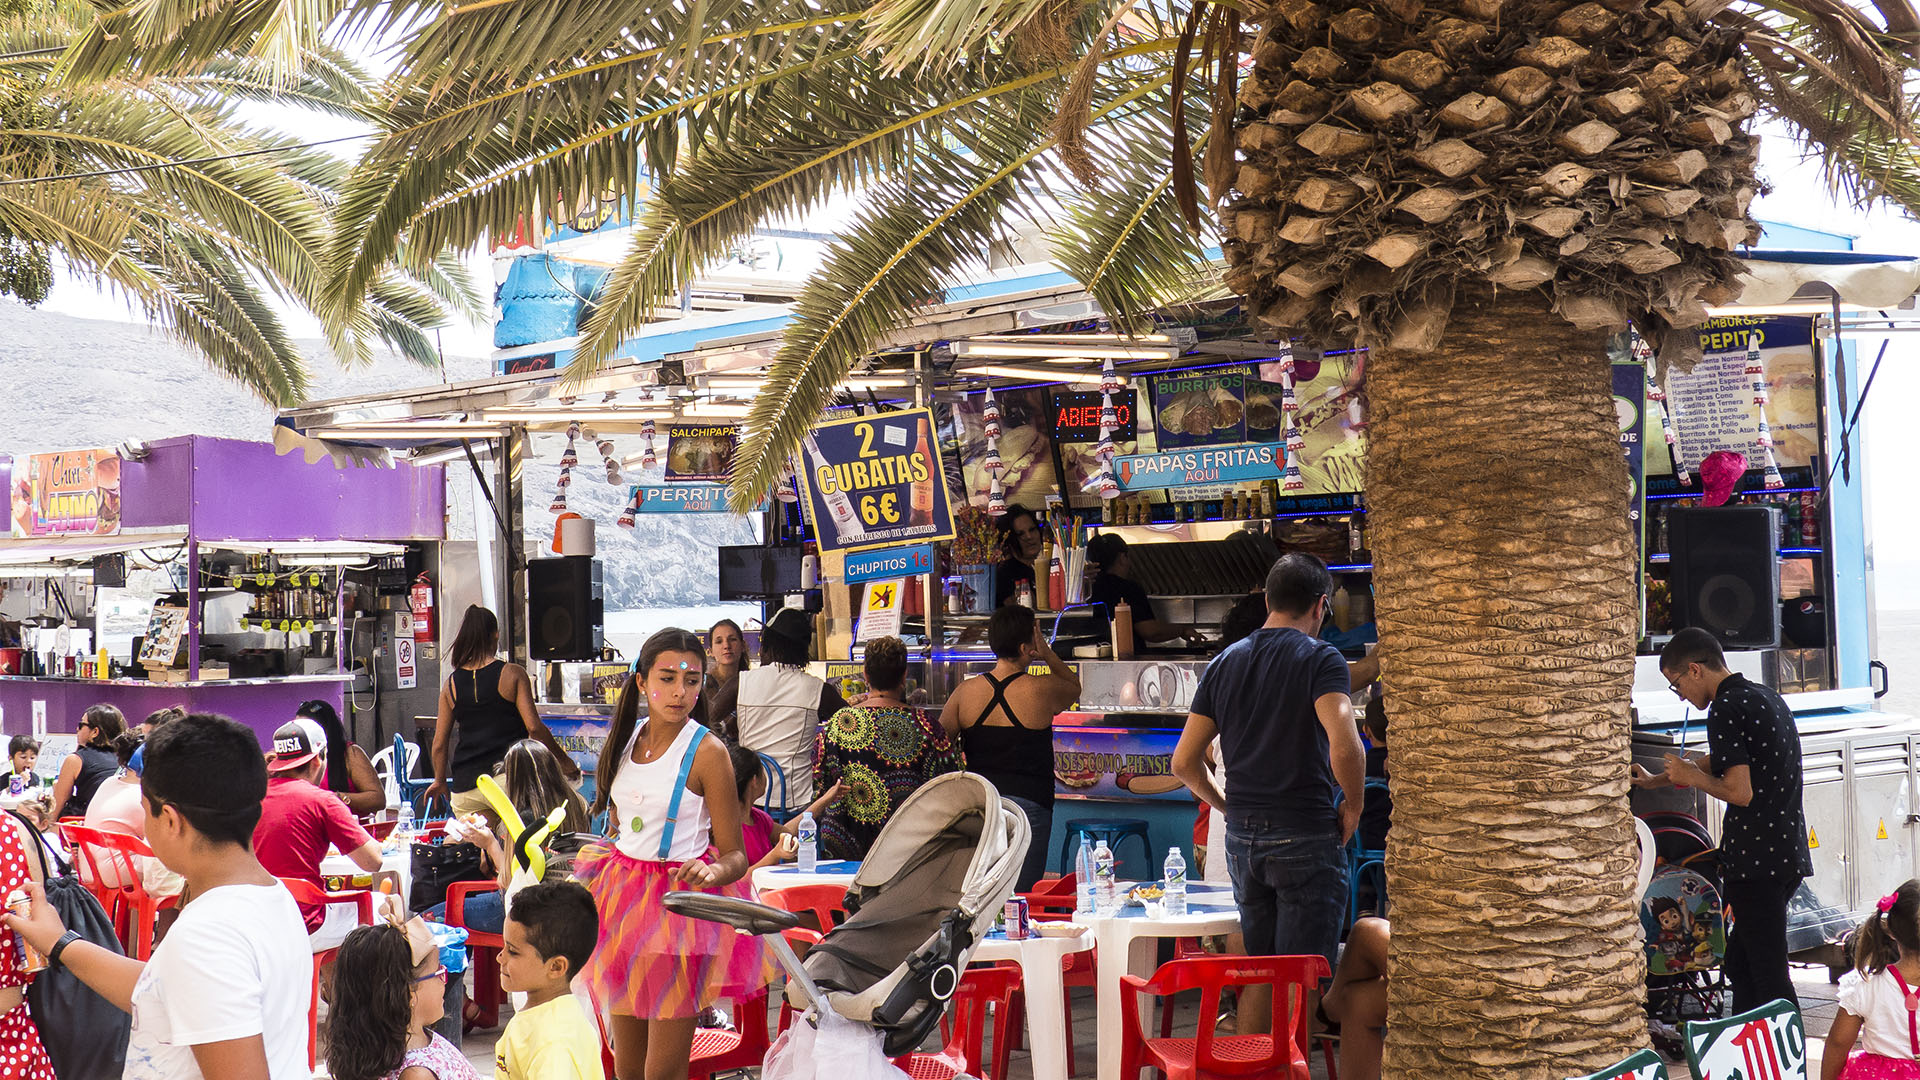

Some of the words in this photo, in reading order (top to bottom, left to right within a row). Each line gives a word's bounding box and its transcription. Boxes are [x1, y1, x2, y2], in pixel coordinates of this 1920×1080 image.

[578, 216, 595, 230] HOT
[1700, 328, 1765, 350] PEPITO
[1721, 354, 1746, 363] Normal
[1722, 362, 1746, 371] Especi
[1717, 369, 1743, 378] Normal
[1158, 375, 1243, 395] BURRITOS
[1670, 380, 1717, 390] Hamburguesa
[1718, 376, 1748, 386] Especial
[1671, 387, 1719, 397] Hamburguesa
[1720, 383, 1740, 392] Doble
[1741, 382, 1750, 390] de
[1695, 393, 1713, 401] locas
[1674, 401, 1706, 410] Bcadillo
[1707, 400, 1716, 408] de
[1718, 406, 1738, 414] Lomo
[1056, 404, 1130, 428] ABIEO
[1676, 415, 1709, 424] Bocadillo
[1709, 414, 1718, 422] de
[1720, 412, 1750, 422] pechuga
[670, 426, 736, 438] SALCHIPAPA
[1677, 423, 1710, 432] Bocadillo
[1711, 422, 1719, 430] de
[1720, 420, 1739, 428] Pollo
[1678, 430, 1707, 438] Burritos
[1708, 428, 1717, 436] de
[853, 422, 879, 459] 2
[1680, 436, 1721, 446] Salchipapas
[1681, 444, 1699, 452] Plato
[1700, 443, 1709, 451] de
[1710, 442, 1731, 450] Papas
[1732, 441, 1746, 449] con
[1133, 452, 1198, 475] PAPAS
[1202, 446, 1273, 470] FRITAS
[1682, 451, 1700, 459] Plato
[816, 451, 930, 496] CUBATAS
[1184, 468, 1220, 483] AQUI
[646, 487, 737, 502] PERRITO
[683, 500, 712, 511] AQUI
[859, 491, 901, 527] 6€
[847, 557, 907, 576] CHUPITOS
[911, 551, 929, 567] 1€
[1054, 752, 1084, 771] NSES
[1087, 752, 1123, 773] COMO
[1126, 754, 1172, 775] PIENSE
